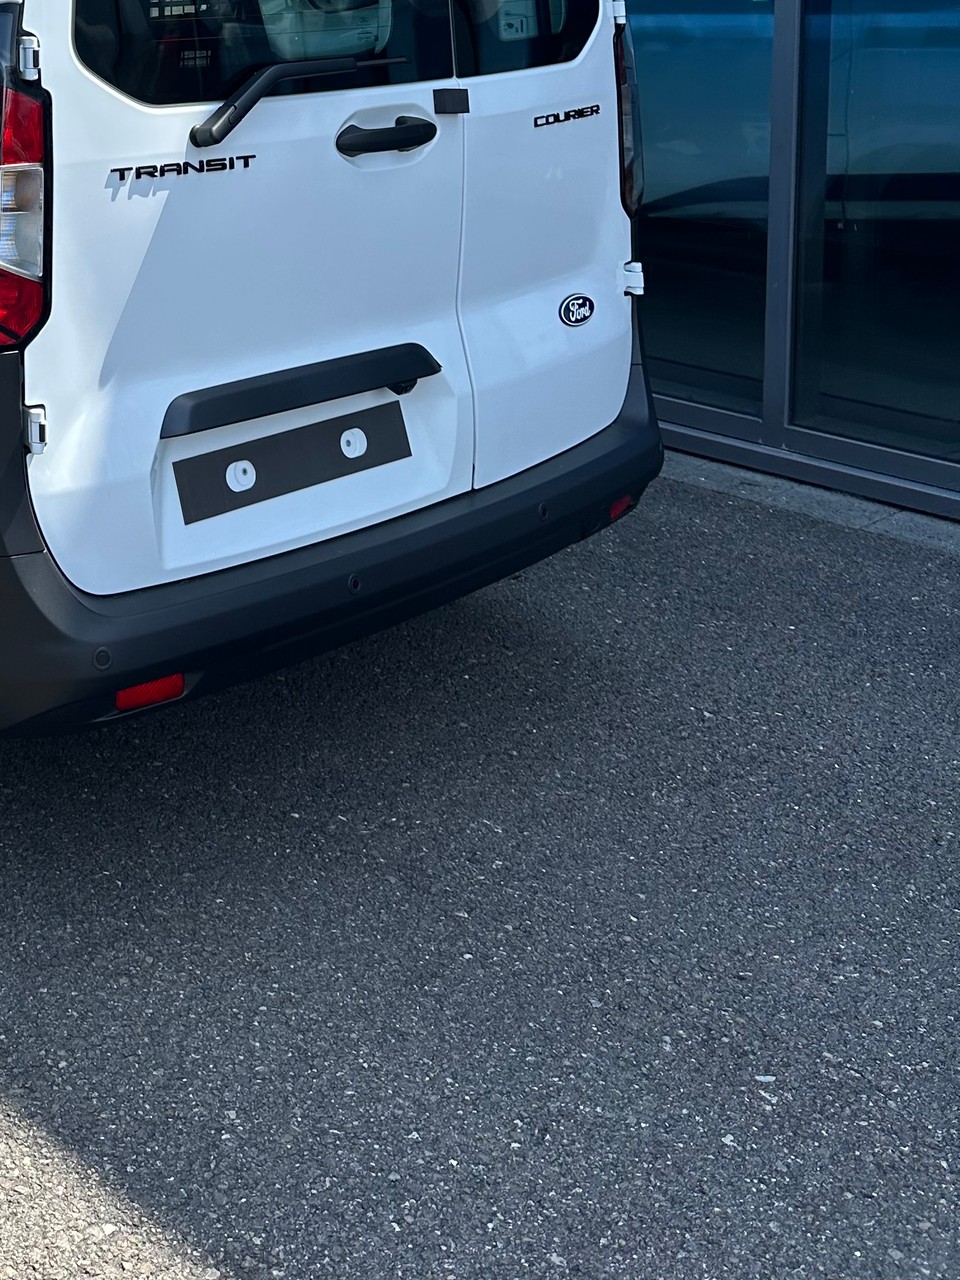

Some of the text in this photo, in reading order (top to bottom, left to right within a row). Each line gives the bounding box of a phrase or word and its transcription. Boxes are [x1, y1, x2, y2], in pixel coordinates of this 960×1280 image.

[534, 104, 600, 128] COURIER
[110, 154, 256, 181] TRANSIT
[569, 298, 590, 321] Ford
